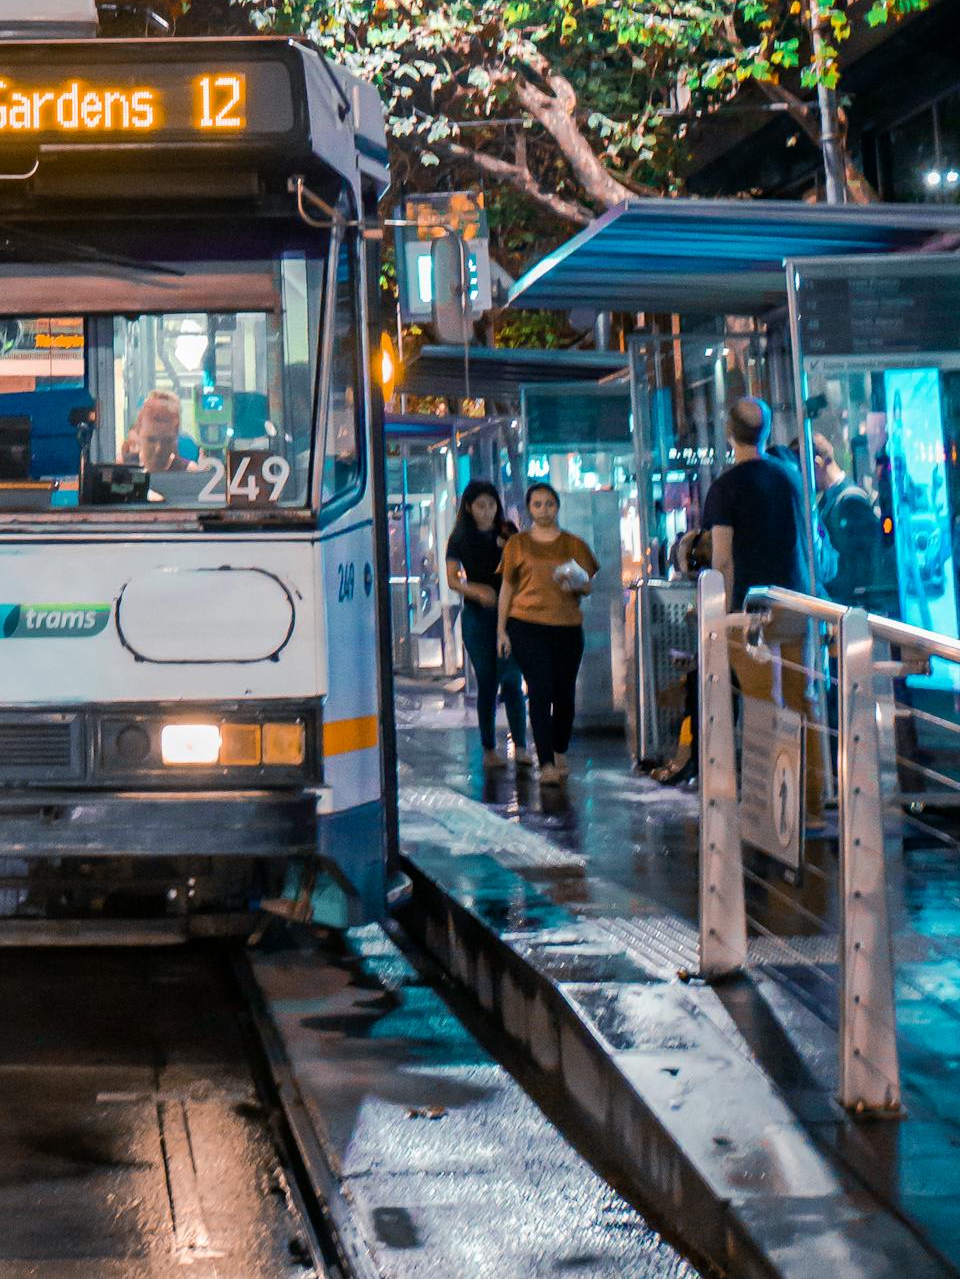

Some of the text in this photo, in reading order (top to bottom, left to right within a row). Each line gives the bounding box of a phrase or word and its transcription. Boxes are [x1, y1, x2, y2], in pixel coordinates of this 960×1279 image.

[199, 76, 241, 127] 12
[198, 455, 290, 502] 249
[25, 608, 96, 629] trams
